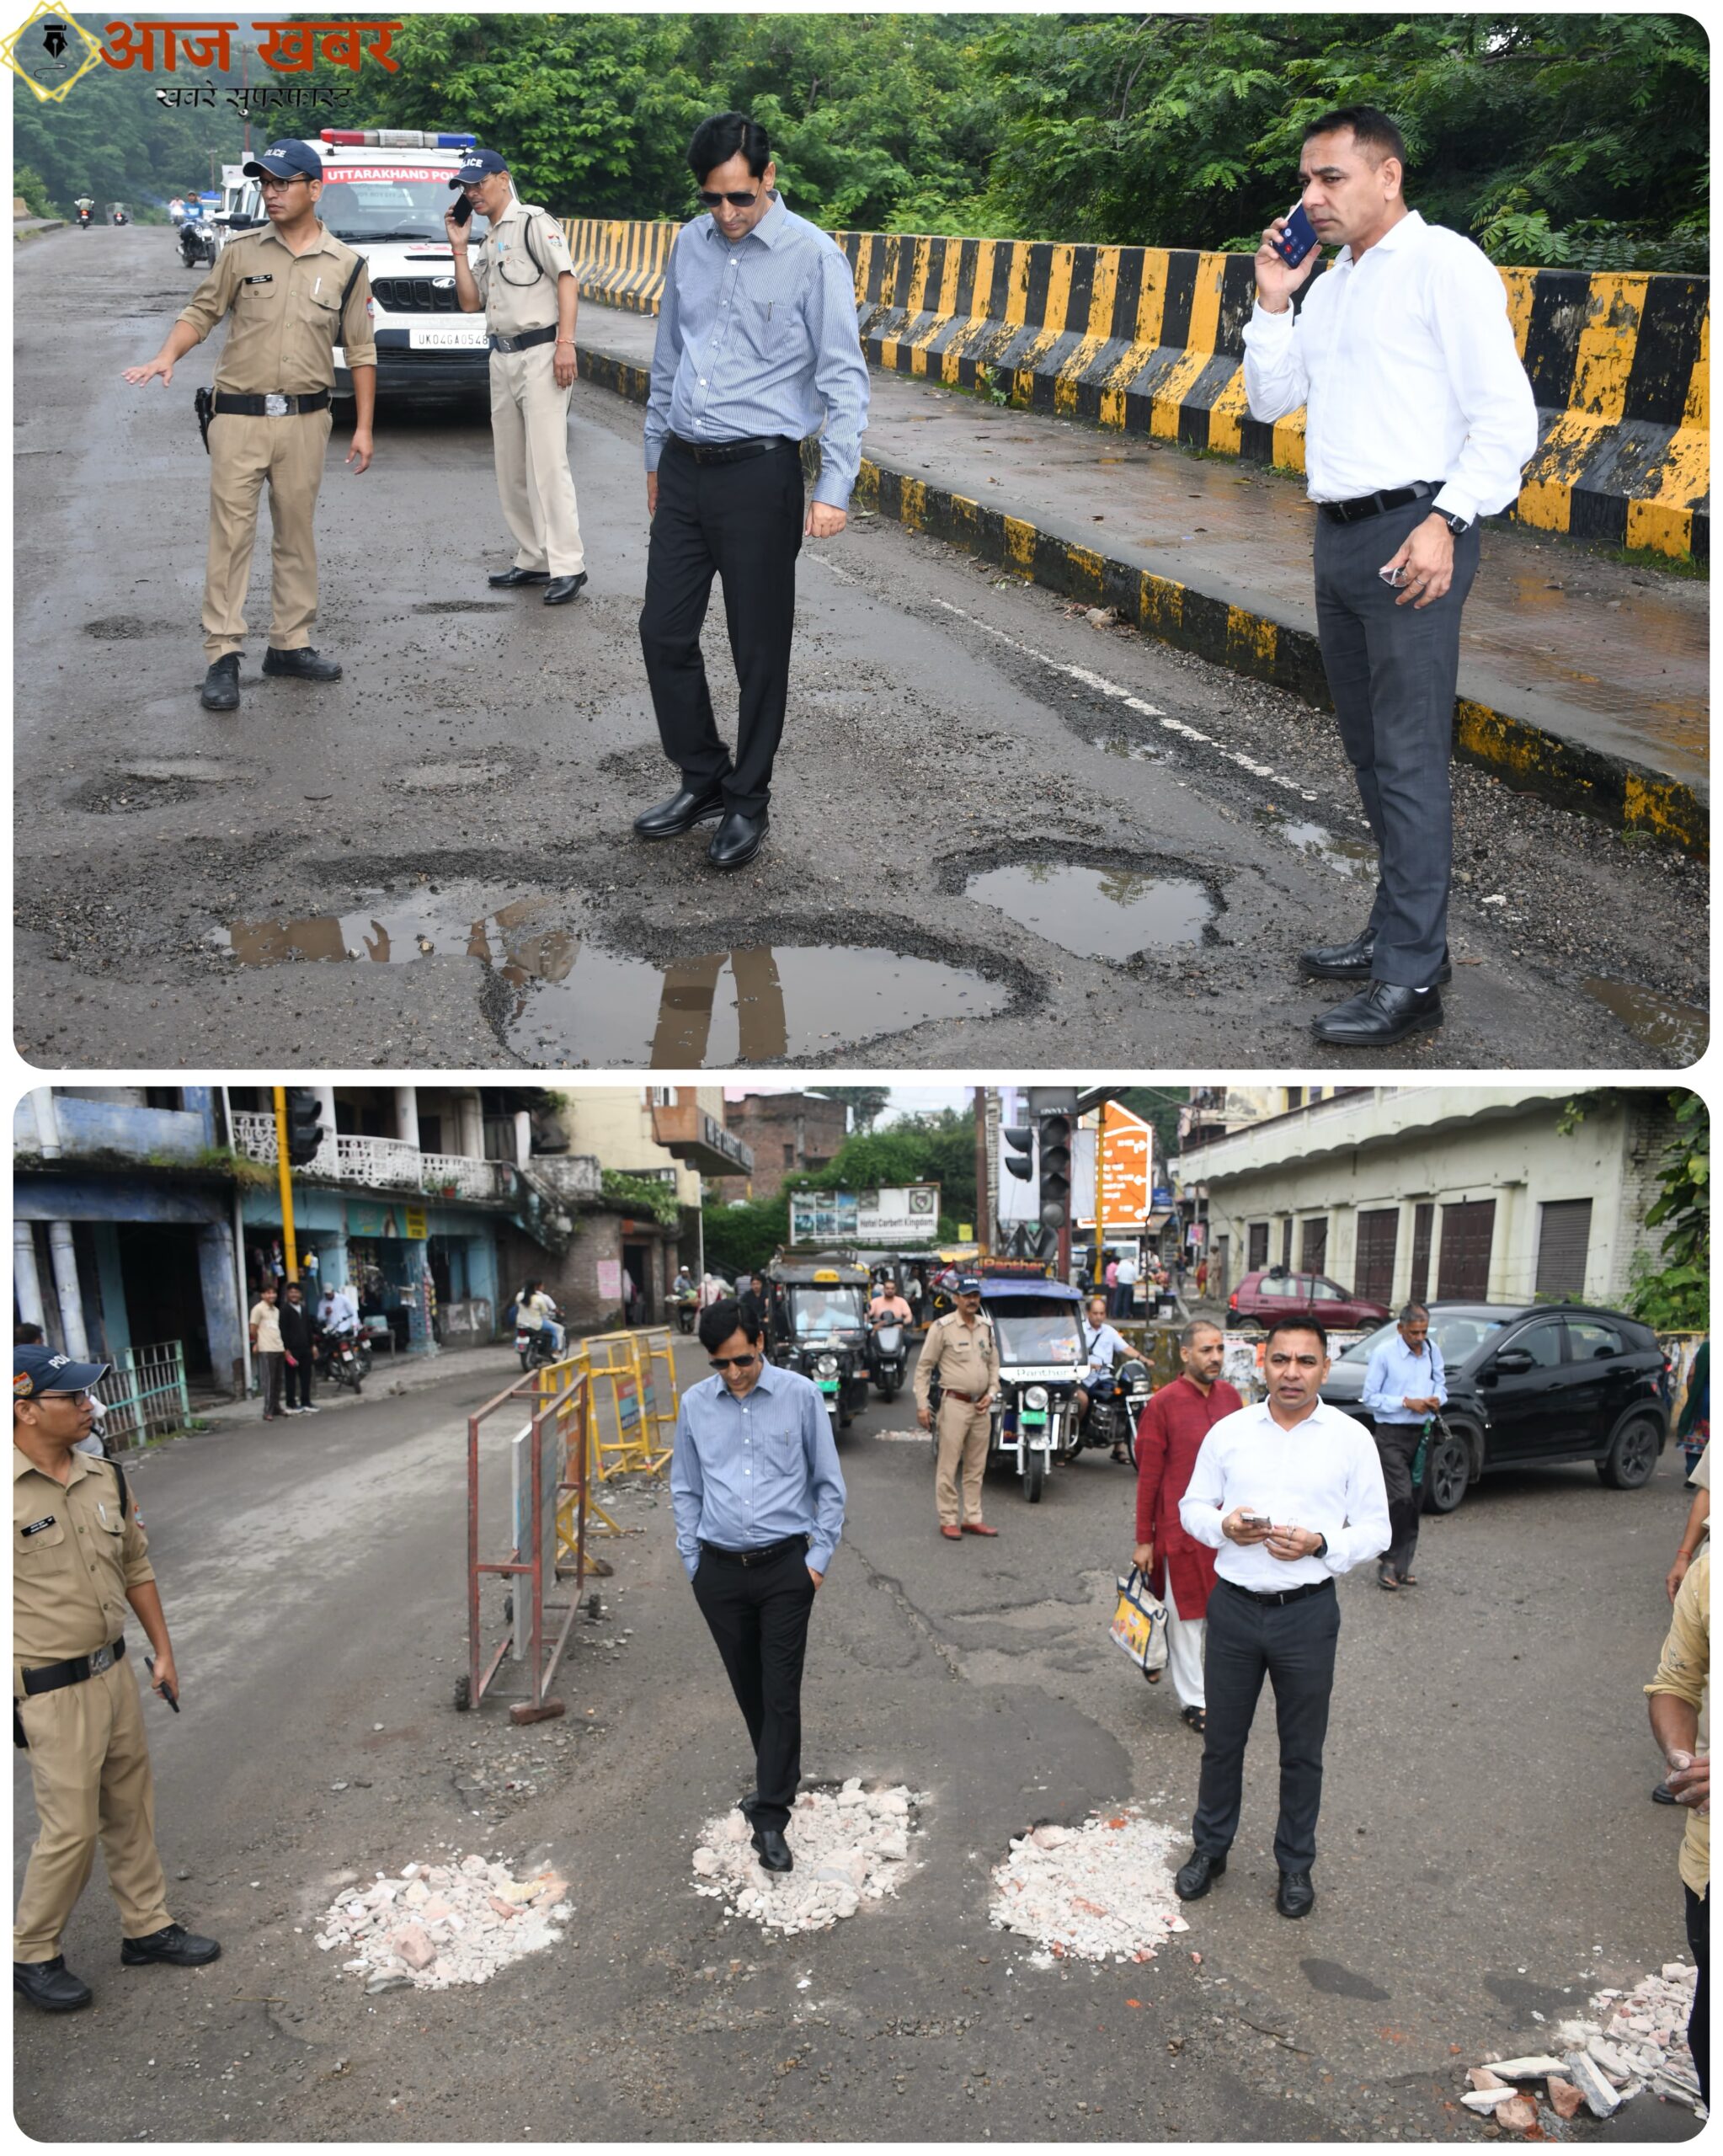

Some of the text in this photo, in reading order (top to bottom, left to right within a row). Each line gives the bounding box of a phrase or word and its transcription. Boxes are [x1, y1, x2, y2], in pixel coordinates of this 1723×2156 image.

[328, 169, 429, 180] UTTARAKHAND
[419, 334, 488, 345] UK04GA0548
[860, 1218, 935, 1230] Hotel Corbett Kingdom
[984, 1259, 1045, 1271] Panther
[1016, 1369, 1068, 1377] Panther
